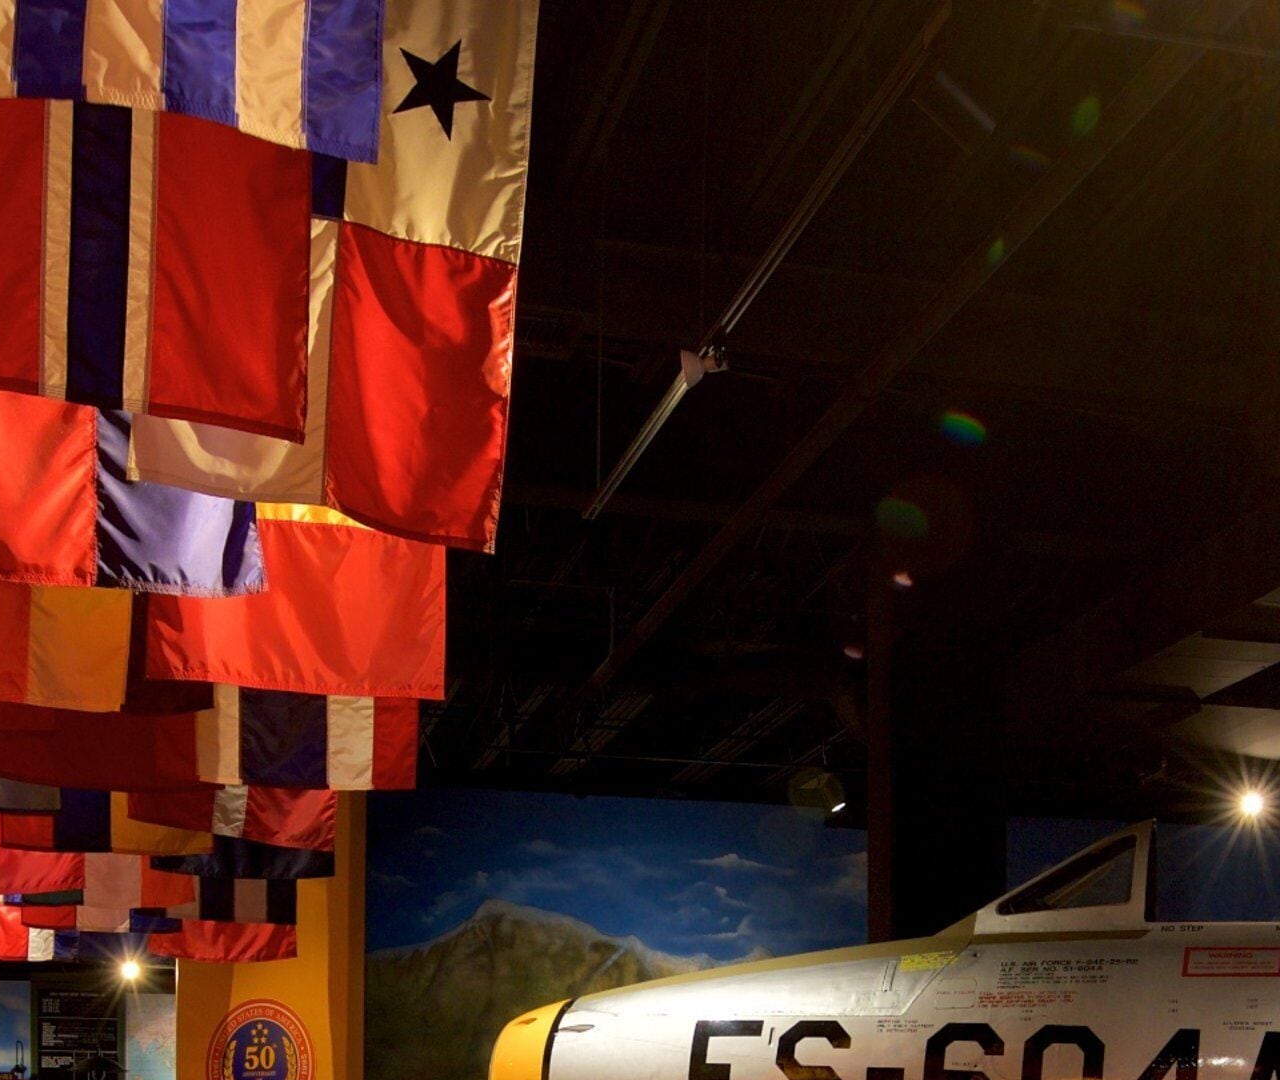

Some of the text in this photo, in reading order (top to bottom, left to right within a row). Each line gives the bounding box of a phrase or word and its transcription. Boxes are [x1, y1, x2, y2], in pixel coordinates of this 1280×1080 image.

[1180, 924, 1204, 932] STEP
[237, 1008, 263, 1022] STATES
[264, 1008, 274, 1016] OF
[276, 1013, 304, 1044] AMERICA
